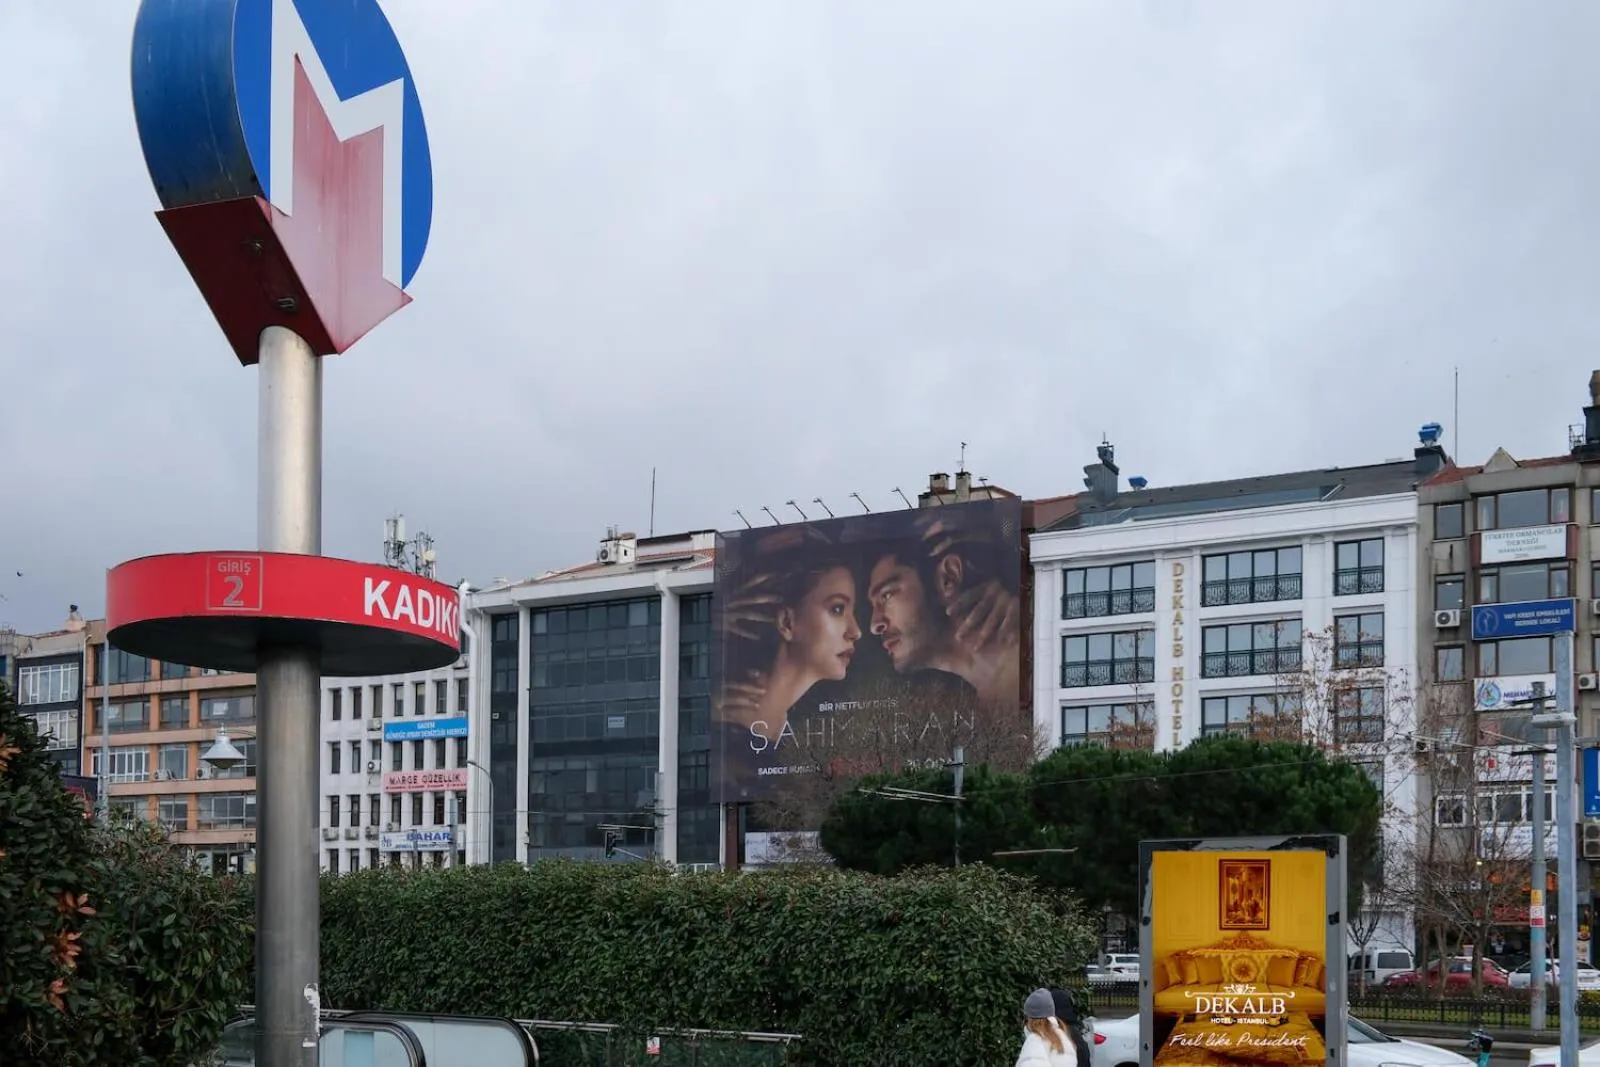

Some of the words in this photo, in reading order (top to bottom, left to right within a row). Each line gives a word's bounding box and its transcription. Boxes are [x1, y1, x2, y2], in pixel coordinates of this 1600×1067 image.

[217, 559, 252, 575] GİRİŞ
[223, 575, 245, 606] 2
[1172, 562, 1185, 658] DEKALB
[819, 701, 833, 712] BİR
[1171, 666, 1185, 746] HOTEL
[758, 766, 788, 776] SADECE
[1195, 996, 1286, 1015] DEKALB
[1211, 1017, 1232, 1025] HOTEL
[1169, 1032, 1202, 1047] Feel
[1204, 1032, 1232, 1047] like
[1236, 1032, 1310, 1047] President
